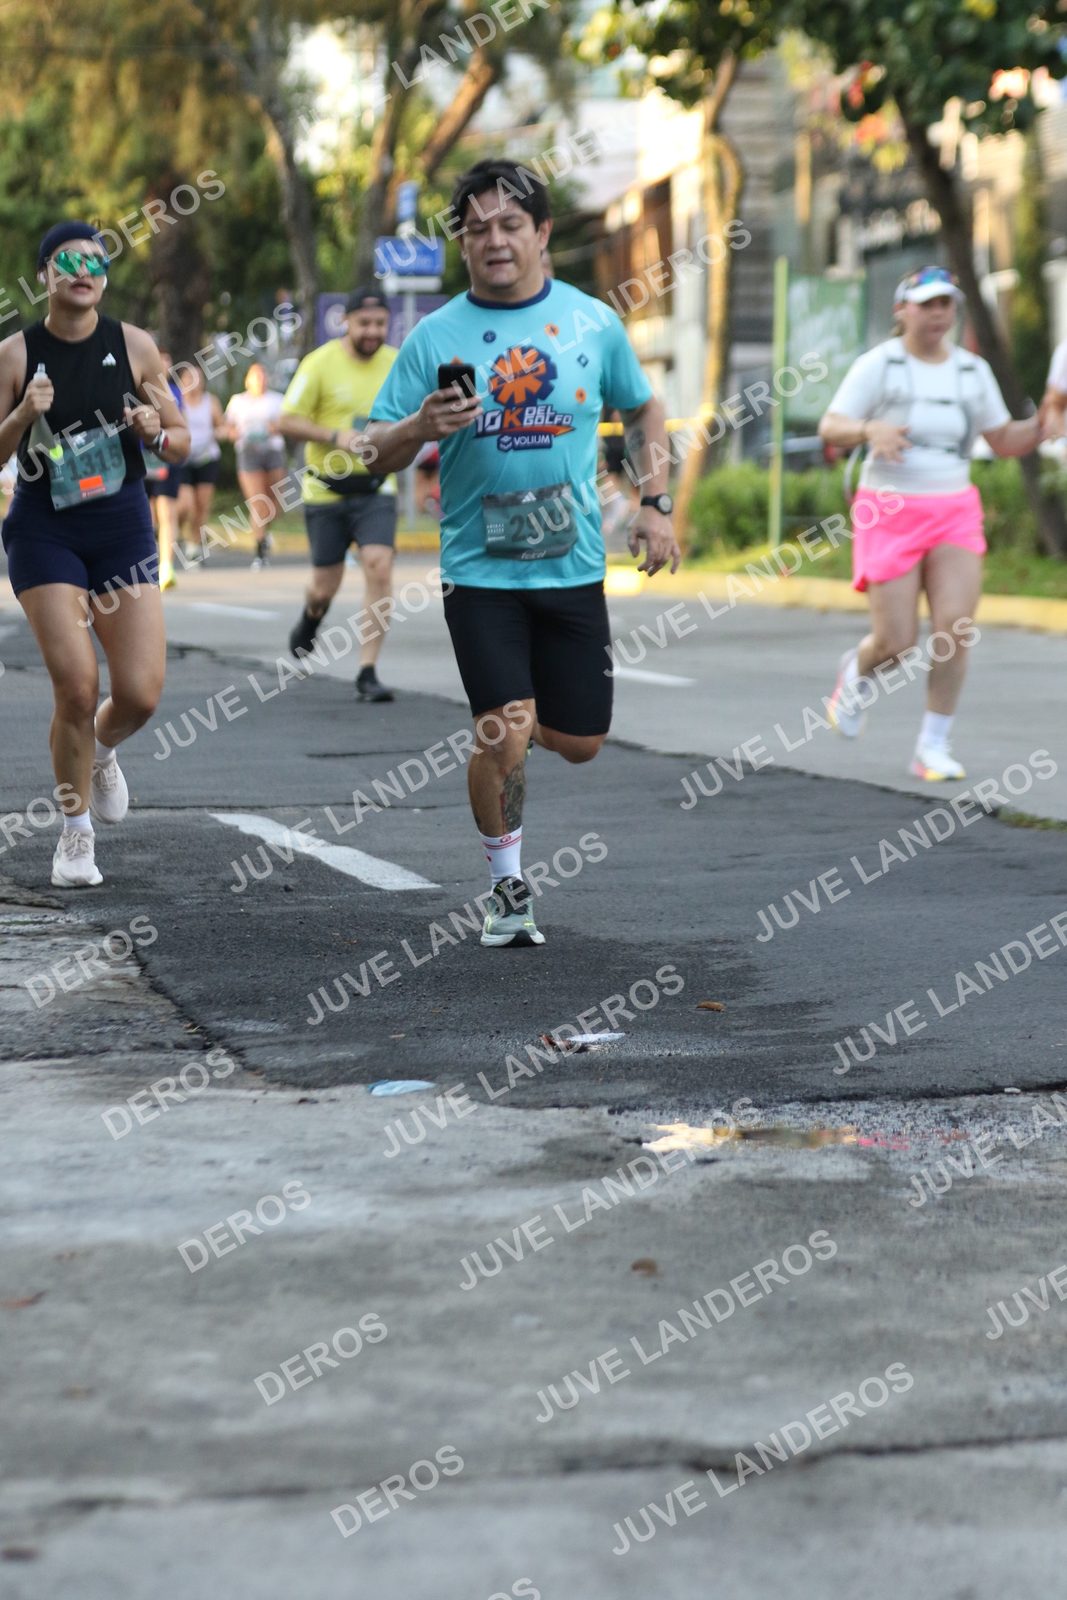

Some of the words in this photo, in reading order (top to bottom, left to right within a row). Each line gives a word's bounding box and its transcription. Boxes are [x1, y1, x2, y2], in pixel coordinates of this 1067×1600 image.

[525, 405, 555, 415] DEL
[523, 414, 573, 426] GOLFO
[513, 435, 551, 446] VOLIUM
